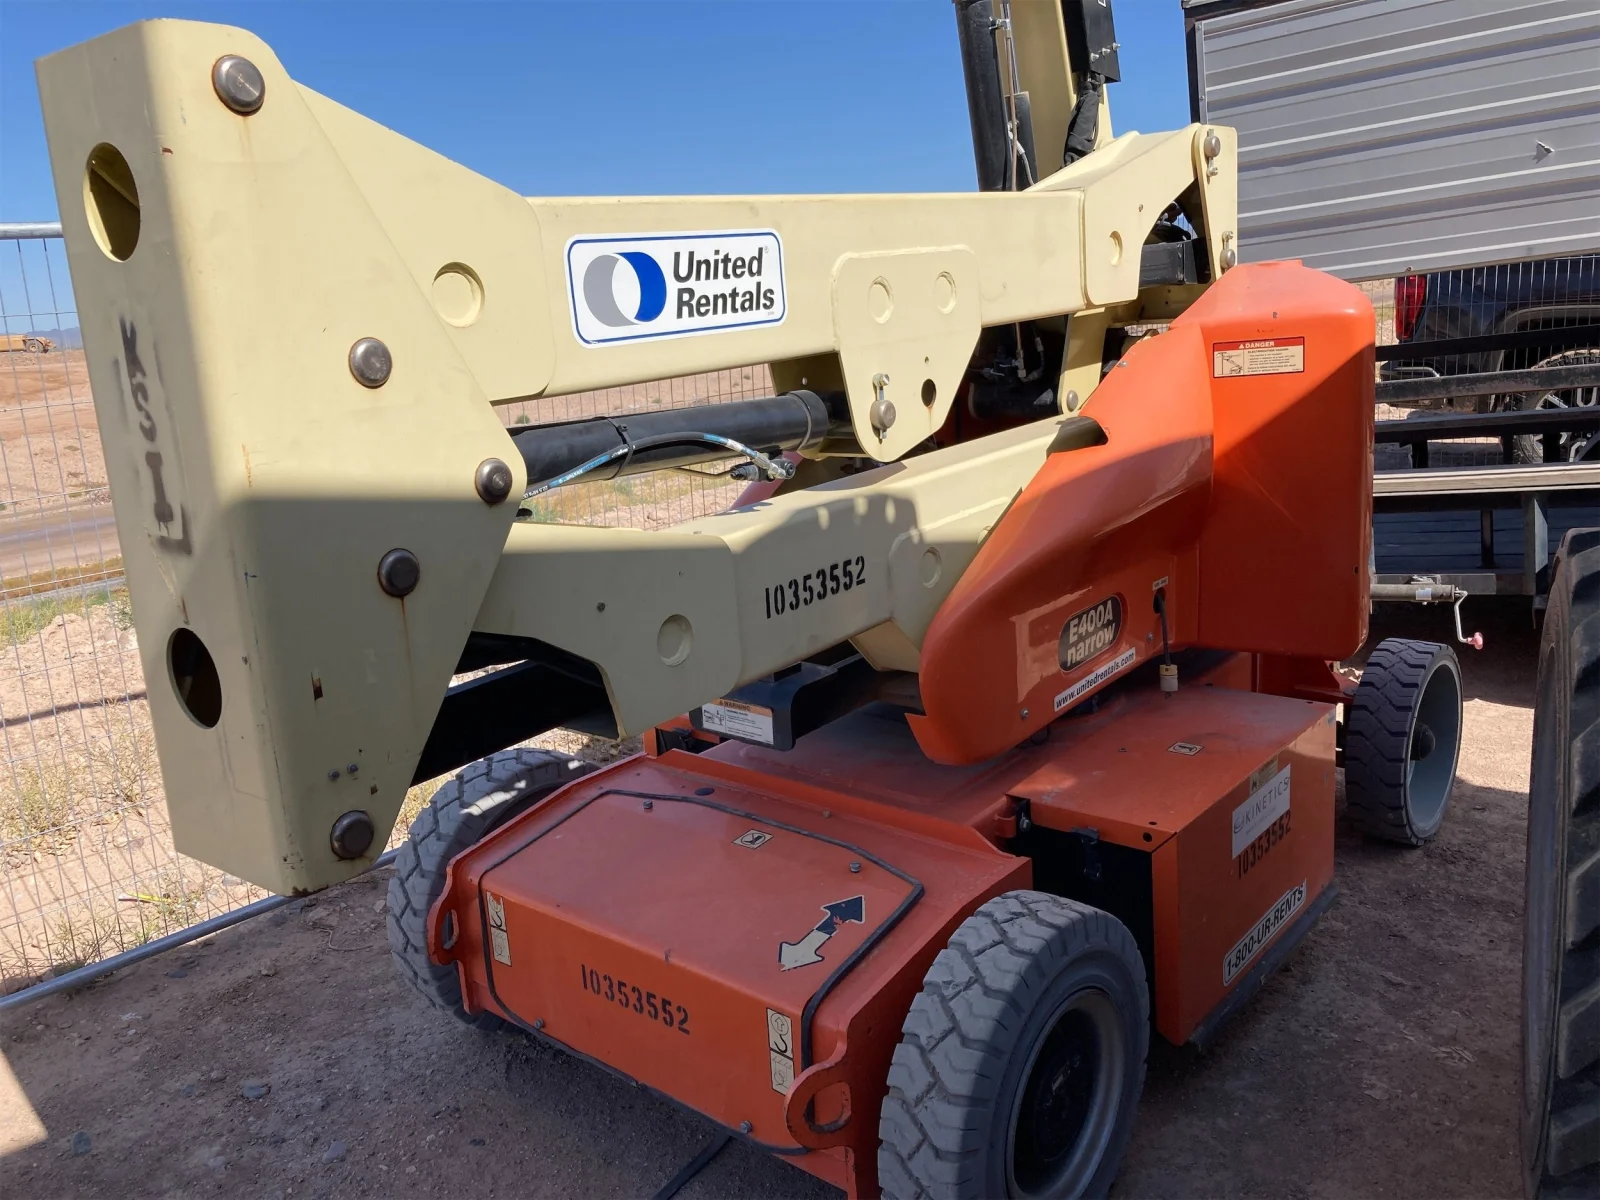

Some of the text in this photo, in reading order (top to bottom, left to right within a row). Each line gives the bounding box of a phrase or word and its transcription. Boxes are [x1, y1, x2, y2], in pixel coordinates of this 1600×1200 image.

[673, 247, 764, 283] United
[676, 281, 775, 319] Rentals
[1245, 341, 1275, 349] DANGER
[765, 555, 866, 619] 10353552
[1069, 600, 1114, 643] E400A
[1067, 623, 1115, 667] narrow
[1056, 652, 1135, 709] www.unitedrentals.com
[724, 702, 751, 711] WARNING
[1245, 777, 1290, 822] KINETICS
[1238, 809, 1291, 879] 10353552
[1227, 884, 1304, 977] 1-800-UR-RENTS
[581, 964, 690, 1035] 10353552
